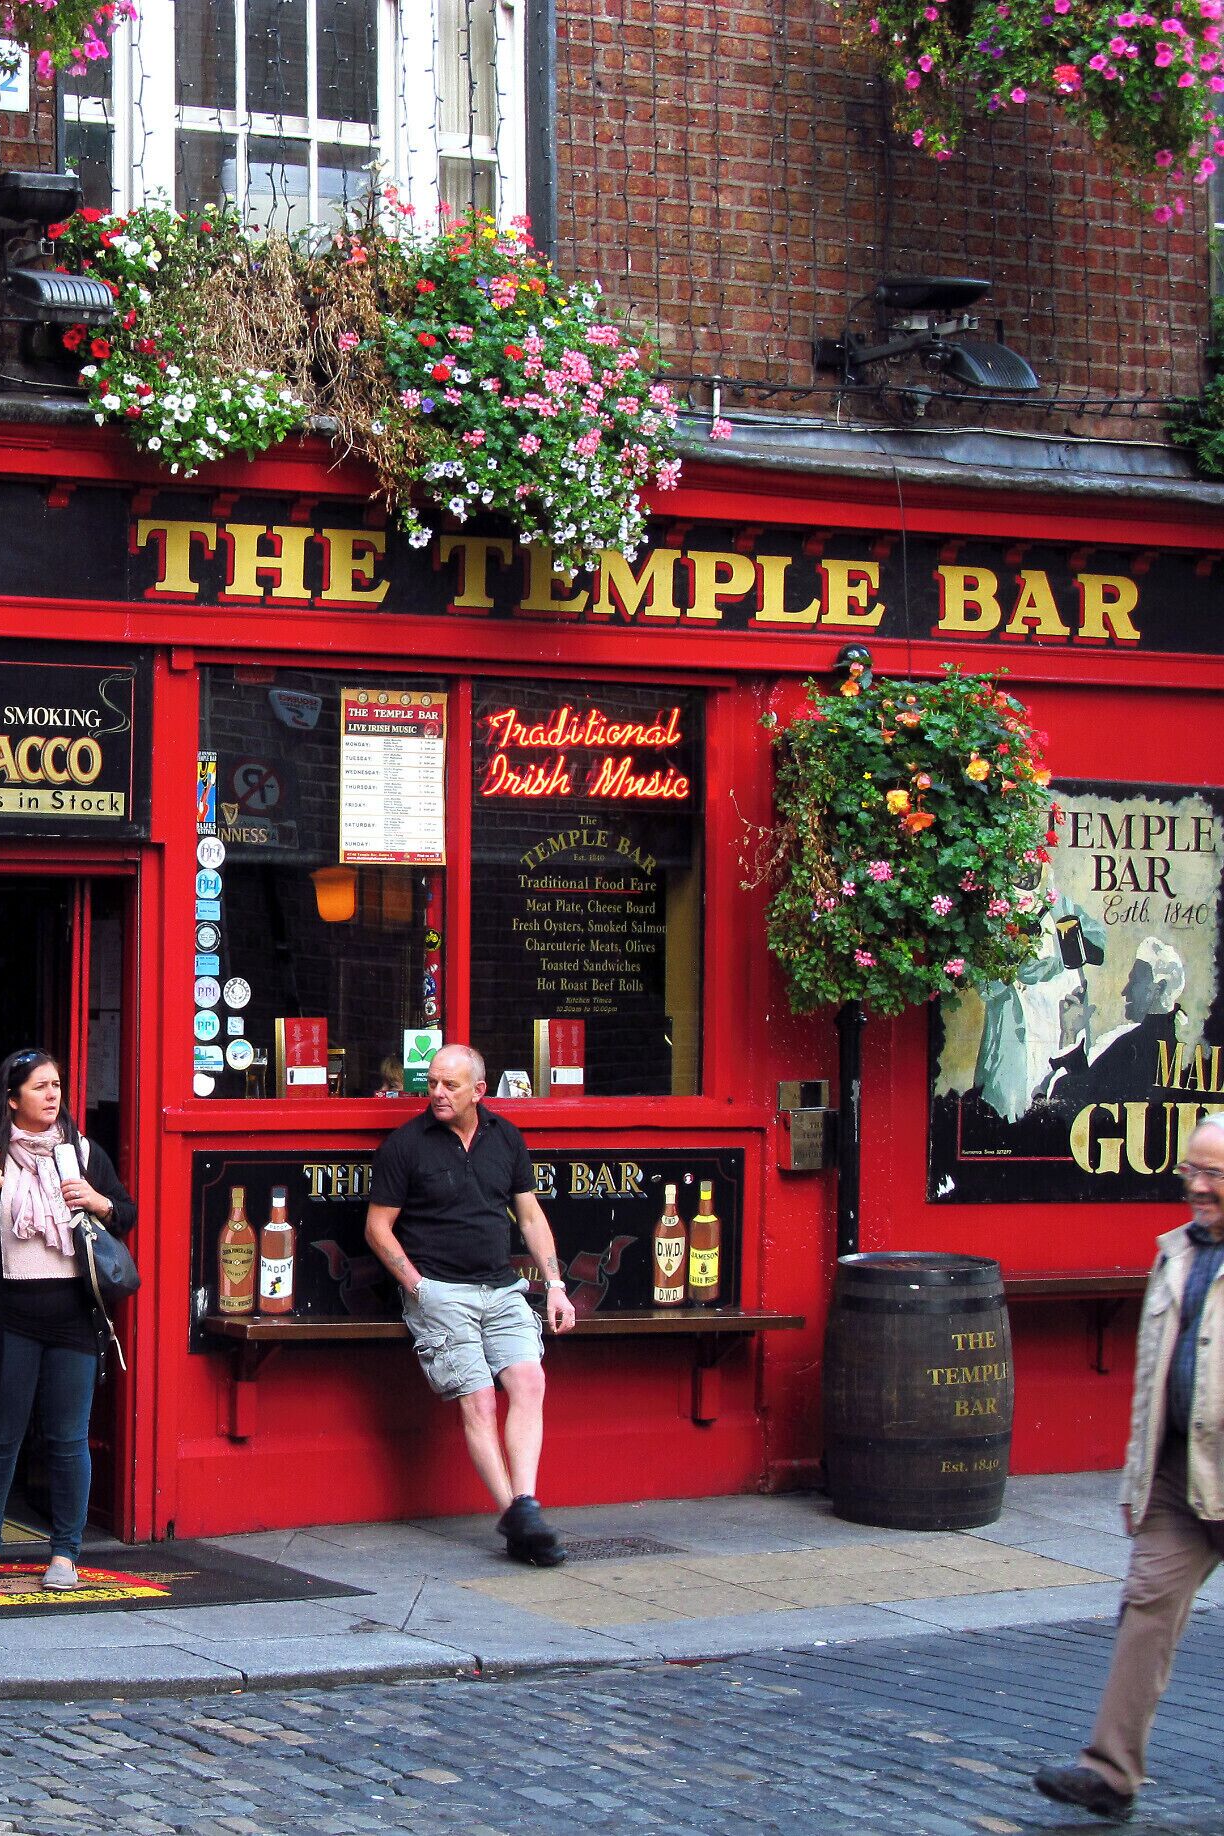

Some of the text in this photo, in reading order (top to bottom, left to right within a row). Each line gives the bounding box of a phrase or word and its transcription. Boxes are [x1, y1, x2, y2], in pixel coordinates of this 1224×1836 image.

[134, 518, 1142, 640] THE TEMPLE BAR
[3, 706, 102, 728] SMOKING
[348, 708, 438, 720] THE TEMPLE BAR
[348, 723, 417, 734] LIVE IRISH MUSIC
[490, 706, 682, 747] Traditional
[484, 754, 689, 798] Irish Music
[18, 791, 39, 809] in
[51, 790, 120, 812] Stock
[578, 816, 597, 825] The
[1040, 810, 1216, 853] TEMPLE
[520, 829, 657, 876] TEMPLE BAR
[518, 874, 656, 891] Traditional Food Fare
[1091, 854, 1177, 899] BAR
[526, 899, 656, 915] Meat Plate, Cheese Board
[1164, 902, 1210, 925] 1840
[512, 918, 668, 936] Fresh Oysters, Smoked Salmon
[525, 938, 656, 953] Charcuterie Meats, Olives
[540, 958, 641, 972] Toasted Sandwiches
[537, 978, 644, 992] Hot Roast Beef Rolls
[1070, 1102, 1224, 1175] GUI
[569, 1162, 645, 1197] BAR
[690, 1251, 719, 1260] JAMESON
[261, 1260, 293, 1273] PADDY
[952, 1331, 996, 1351] THE
[926, 1361, 1008, 1386] TEMPLE
[954, 1397, 998, 1417] BAR
[940, 1460, 968, 1474] Est.
